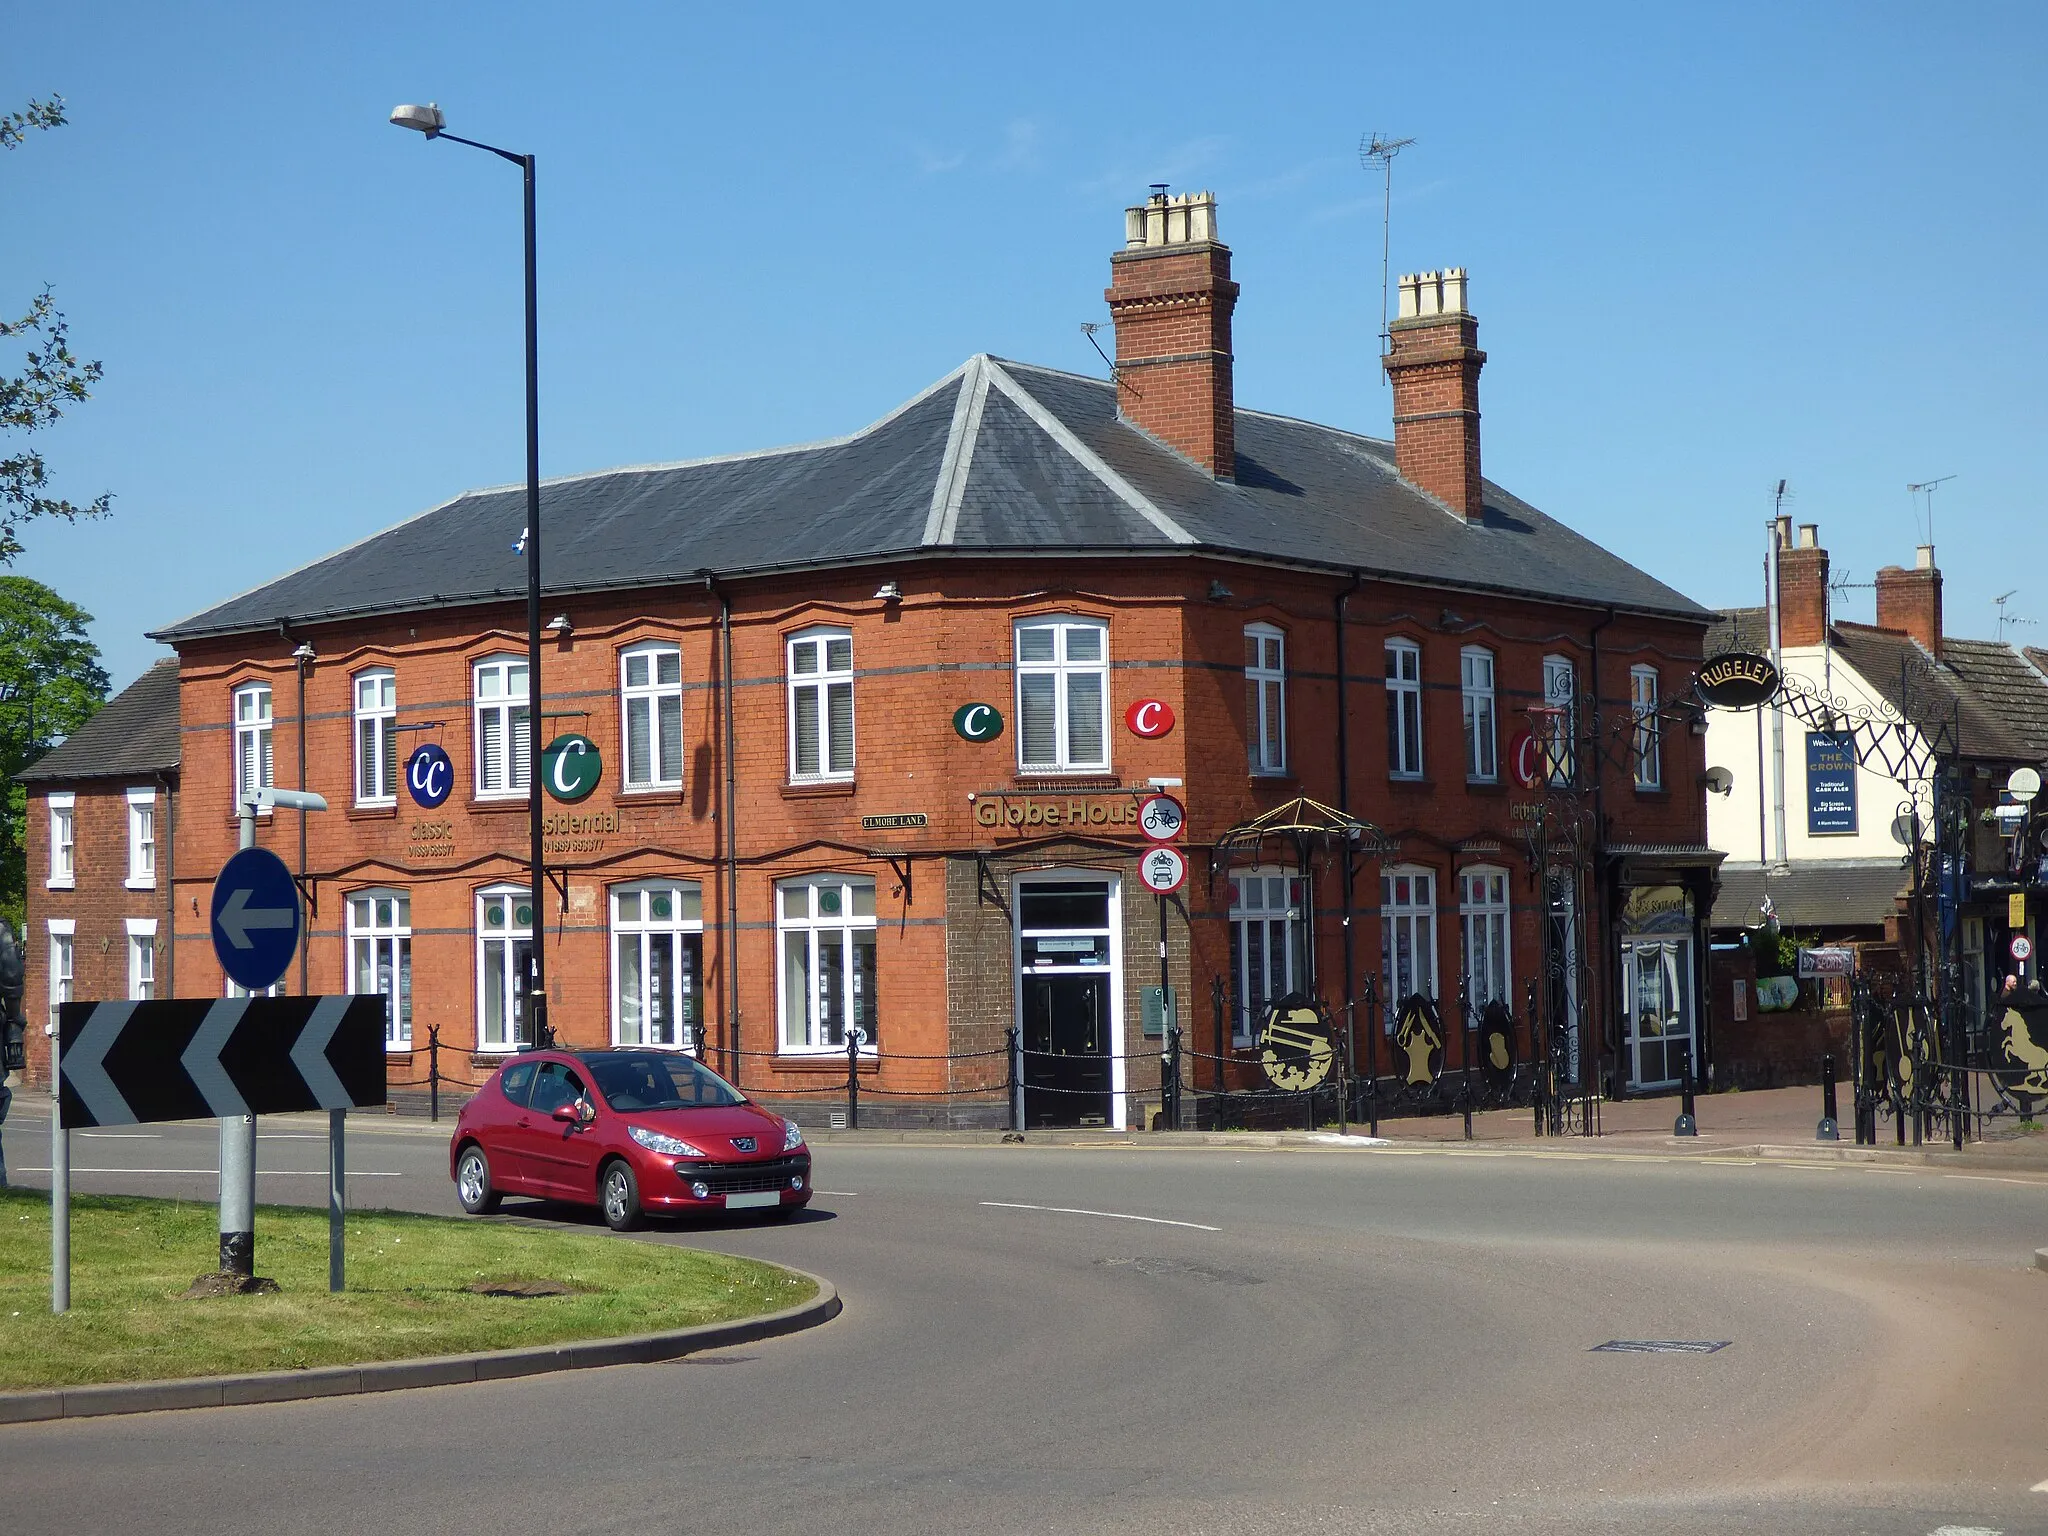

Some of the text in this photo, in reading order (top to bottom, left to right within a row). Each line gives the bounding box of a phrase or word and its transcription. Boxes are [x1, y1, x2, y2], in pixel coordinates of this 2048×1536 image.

[1700, 660, 1774, 687] RUGELEY
[964, 705, 991, 736] C
[1136, 702, 1161, 733] C
[553, 739, 586, 793] C
[1810, 763, 1853, 771] CROWN
[1820, 753, 1843, 761] THE
[530, 810, 620, 836] sidential
[863, 815, 923, 827] ELMORE LANE
[975, 799, 1138, 826] Globe Hous
[411, 818, 453, 841] classic
[245, 1115, 252, 1123] 2
